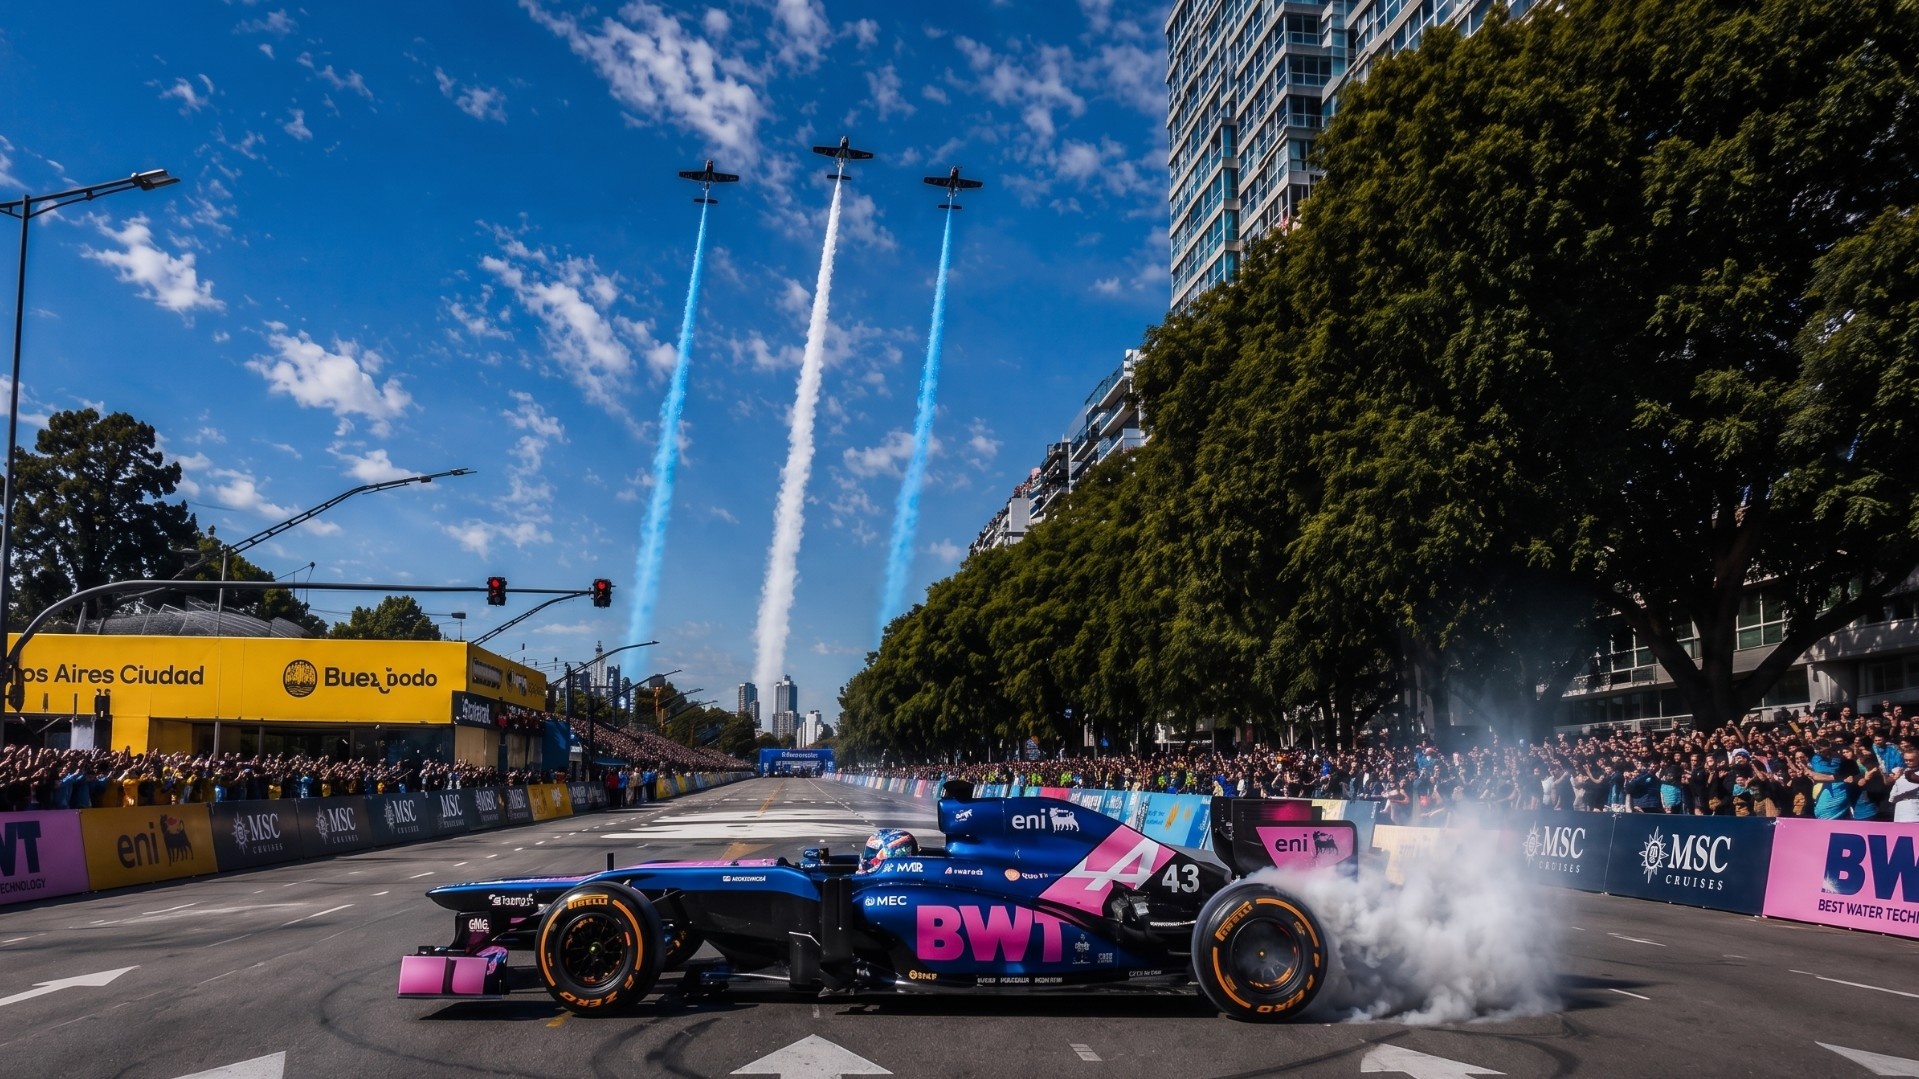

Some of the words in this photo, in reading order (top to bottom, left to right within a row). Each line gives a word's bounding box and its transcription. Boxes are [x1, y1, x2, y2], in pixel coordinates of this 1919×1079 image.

[54, 664, 114, 684] Aires
[120, 665, 204, 685] Ciudad
[392, 799, 417, 823] MSC
[440, 794, 463, 818] MSC
[247, 813, 281, 841] MSC
[327, 807, 357, 833] MSC
[1011, 808, 1046, 830] eni
[117, 821, 160, 869] eni
[1274, 834, 1308, 852] eni
[1541, 826, 1586, 859] MSC
[1667, 833, 1732, 874] MSC
[1161, 864, 1200, 893] 43
[1538, 861, 1581, 873] CRUISES
[1823, 832, 1919, 904] BW
[1665, 875, 1724, 891] CRUISES
[877, 895, 908, 906] MEC
[1818, 899, 1845, 914] BEST
[1846, 903, 1884, 919] WATER
[916, 904, 1071, 963] BWT
[559, 991, 618, 1008] ZERO
